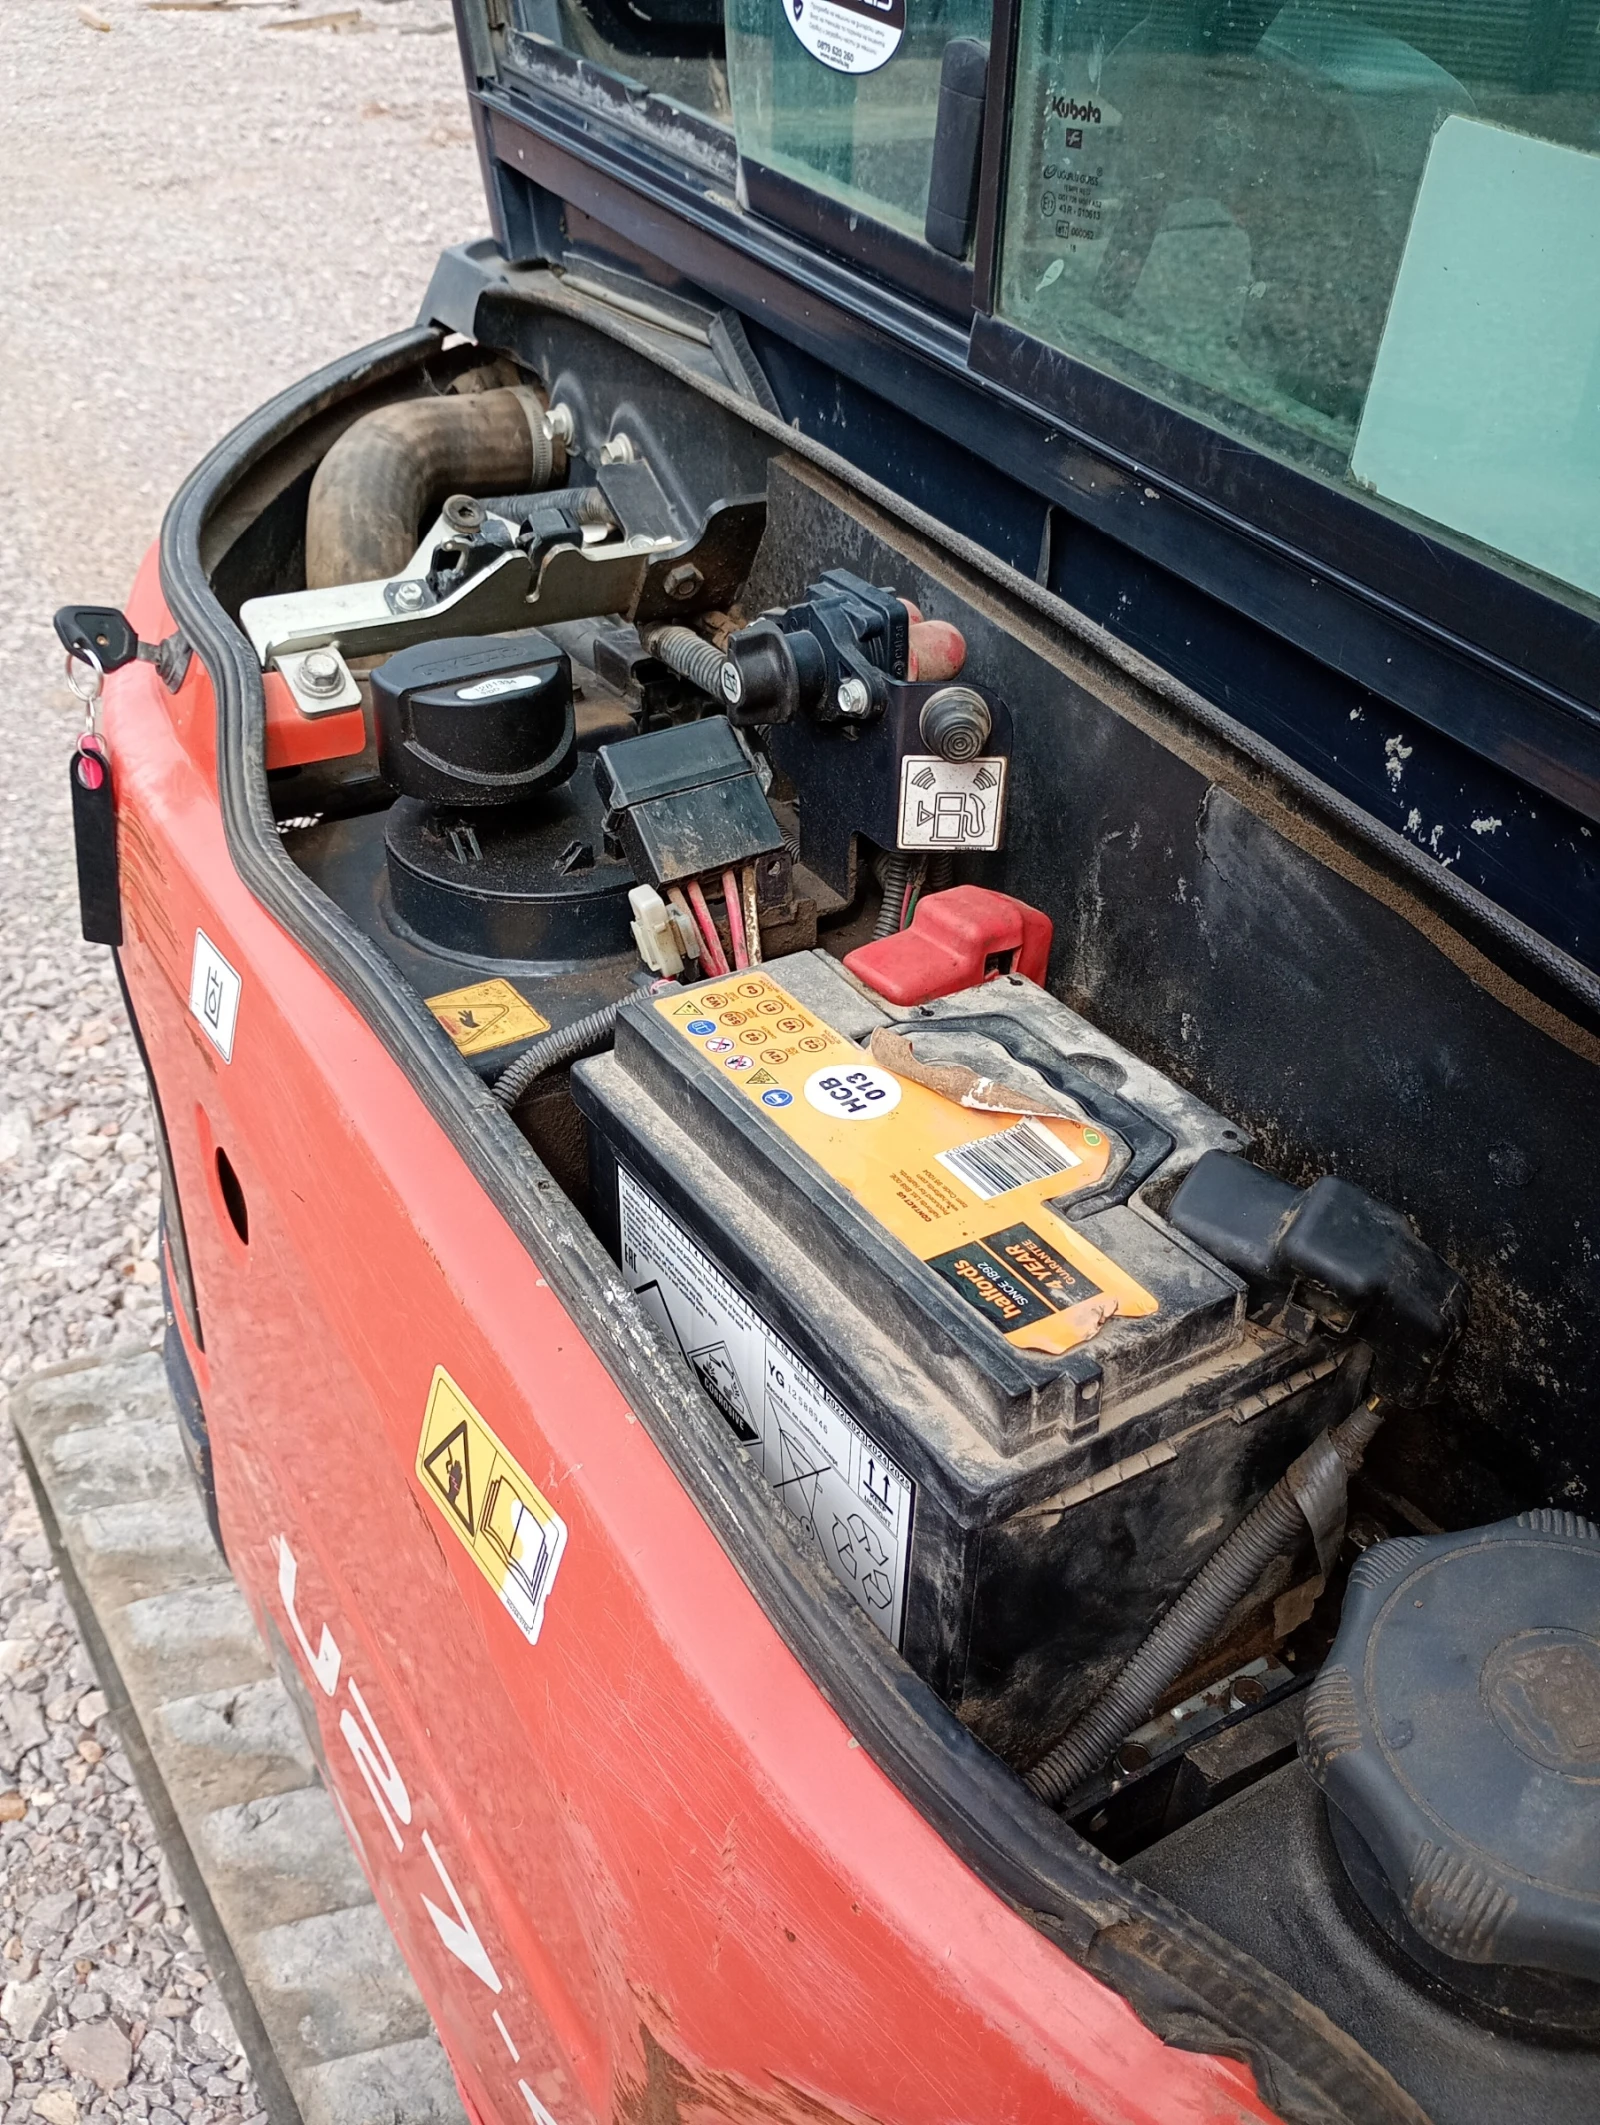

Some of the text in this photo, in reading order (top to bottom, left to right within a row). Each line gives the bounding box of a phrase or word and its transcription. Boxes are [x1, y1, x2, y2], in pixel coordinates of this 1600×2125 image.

[1052, 96, 1101, 124] Kubota
[706, 996, 721, 1008] W3
[783, 1019, 796, 1031] V2
[766, 1051, 784, 1063] 12V
[804, 1040, 819, 1050] C2
[819, 1077, 867, 1113] HCB
[846, 1072, 886, 1101] 013
[904, 1199, 932, 1222] CONTACT
[1005, 1244, 1064, 1290] 4 YEAR
[1021, 1238, 1076, 1285] GUARANTEE
[953, 1259, 1022, 1319] halfords
[976, 1261, 1029, 1306] SINCE 1892
[767, 1357, 785, 1390] YG
[704, 1377, 745, 1431] CORROSIVE
[780, 1343, 788, 1356] 10
[796, 1360, 804, 1373] 11
[812, 1378, 821, 1391] 12
[825, 1394, 845, 1420] 2022
[846, 1416, 866, 1443] 2023
[867, 1439, 887, 1466] 2024
[889, 1463, 911, 1490] 2025
[863, 1492, 891, 1530] UPRIGHT
[868, 1490, 886, 1515] KEEP
